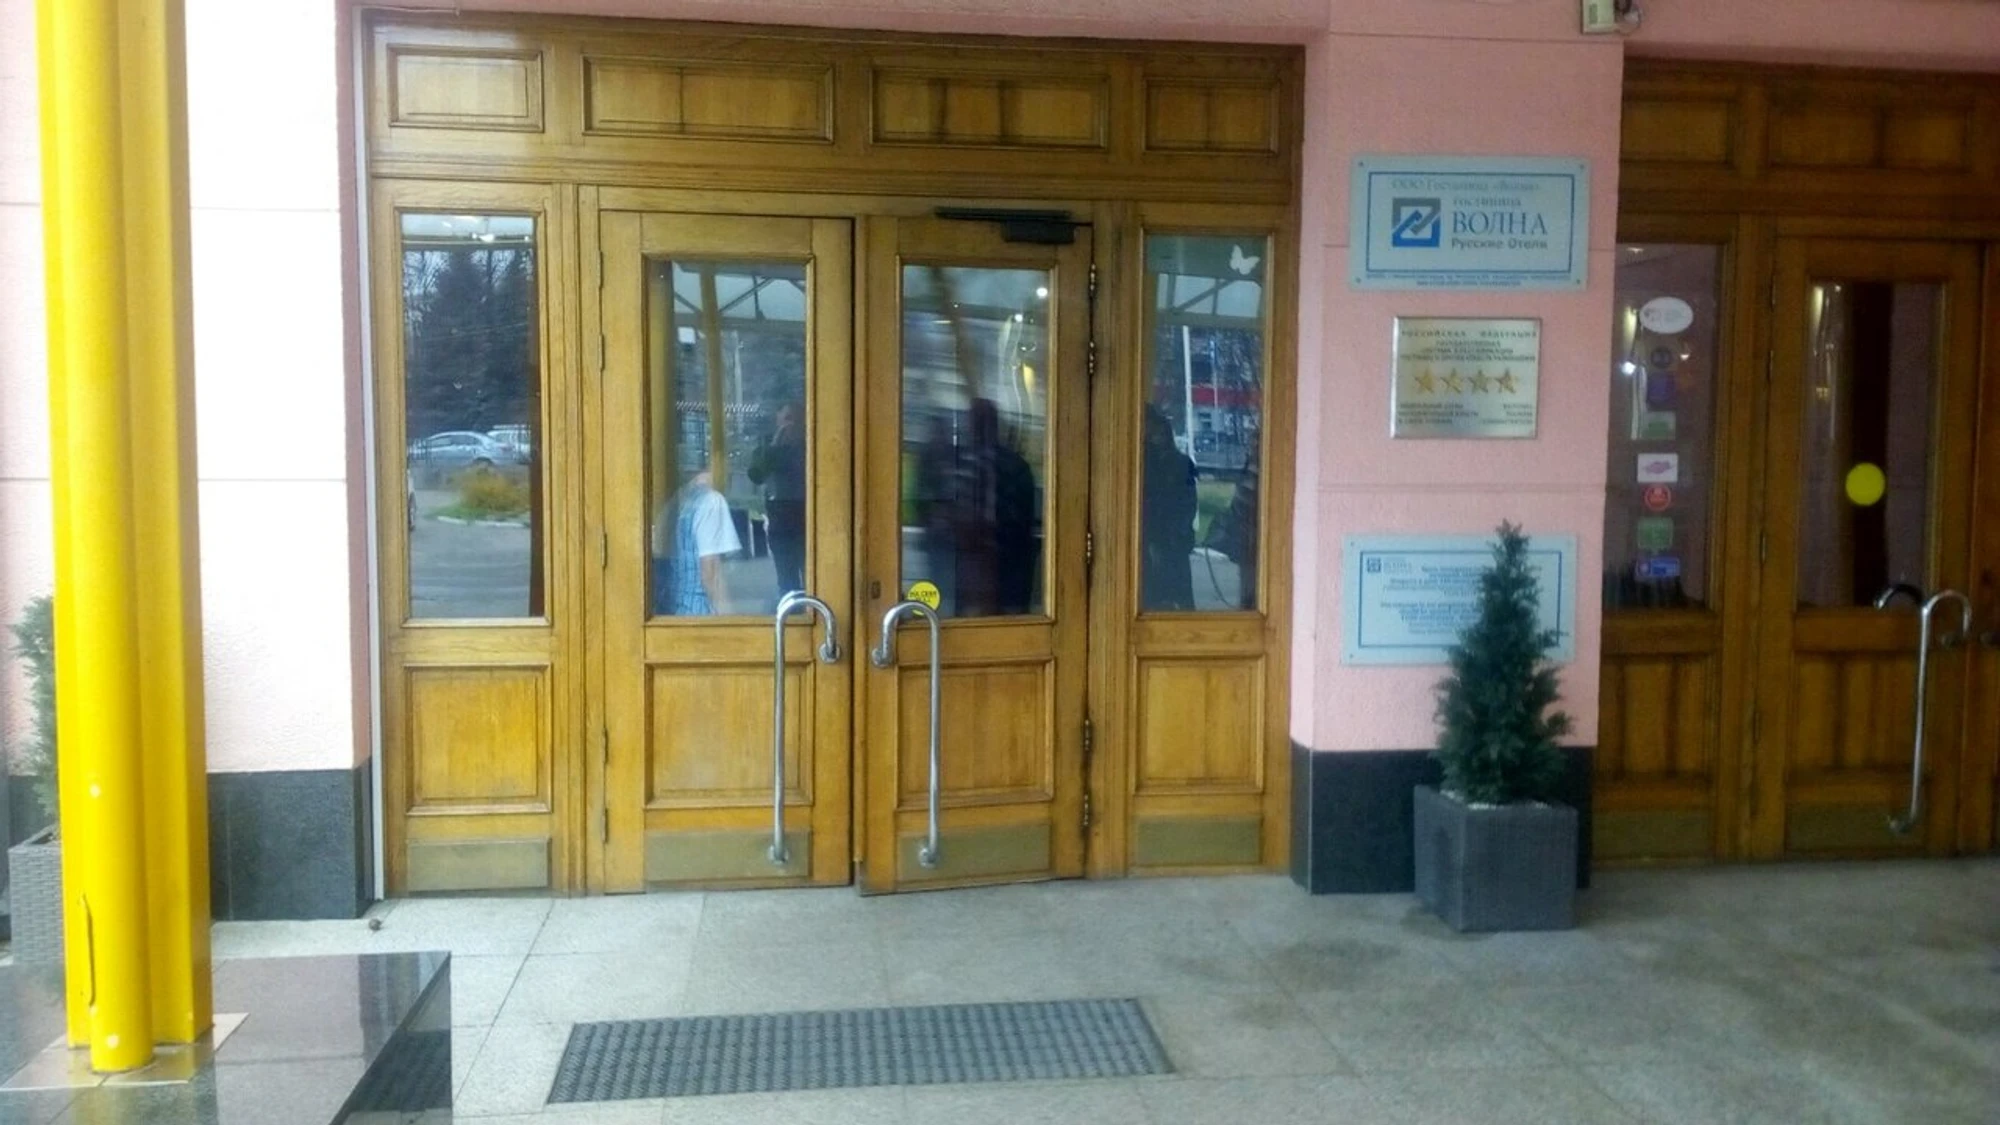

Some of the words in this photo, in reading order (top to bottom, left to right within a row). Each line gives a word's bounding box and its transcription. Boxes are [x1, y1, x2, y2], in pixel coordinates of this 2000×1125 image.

[1452, 211, 1548, 235] ВОЛНА
[1451, 238, 1503, 250] Русские
[1508, 238, 1548, 249] Отели
